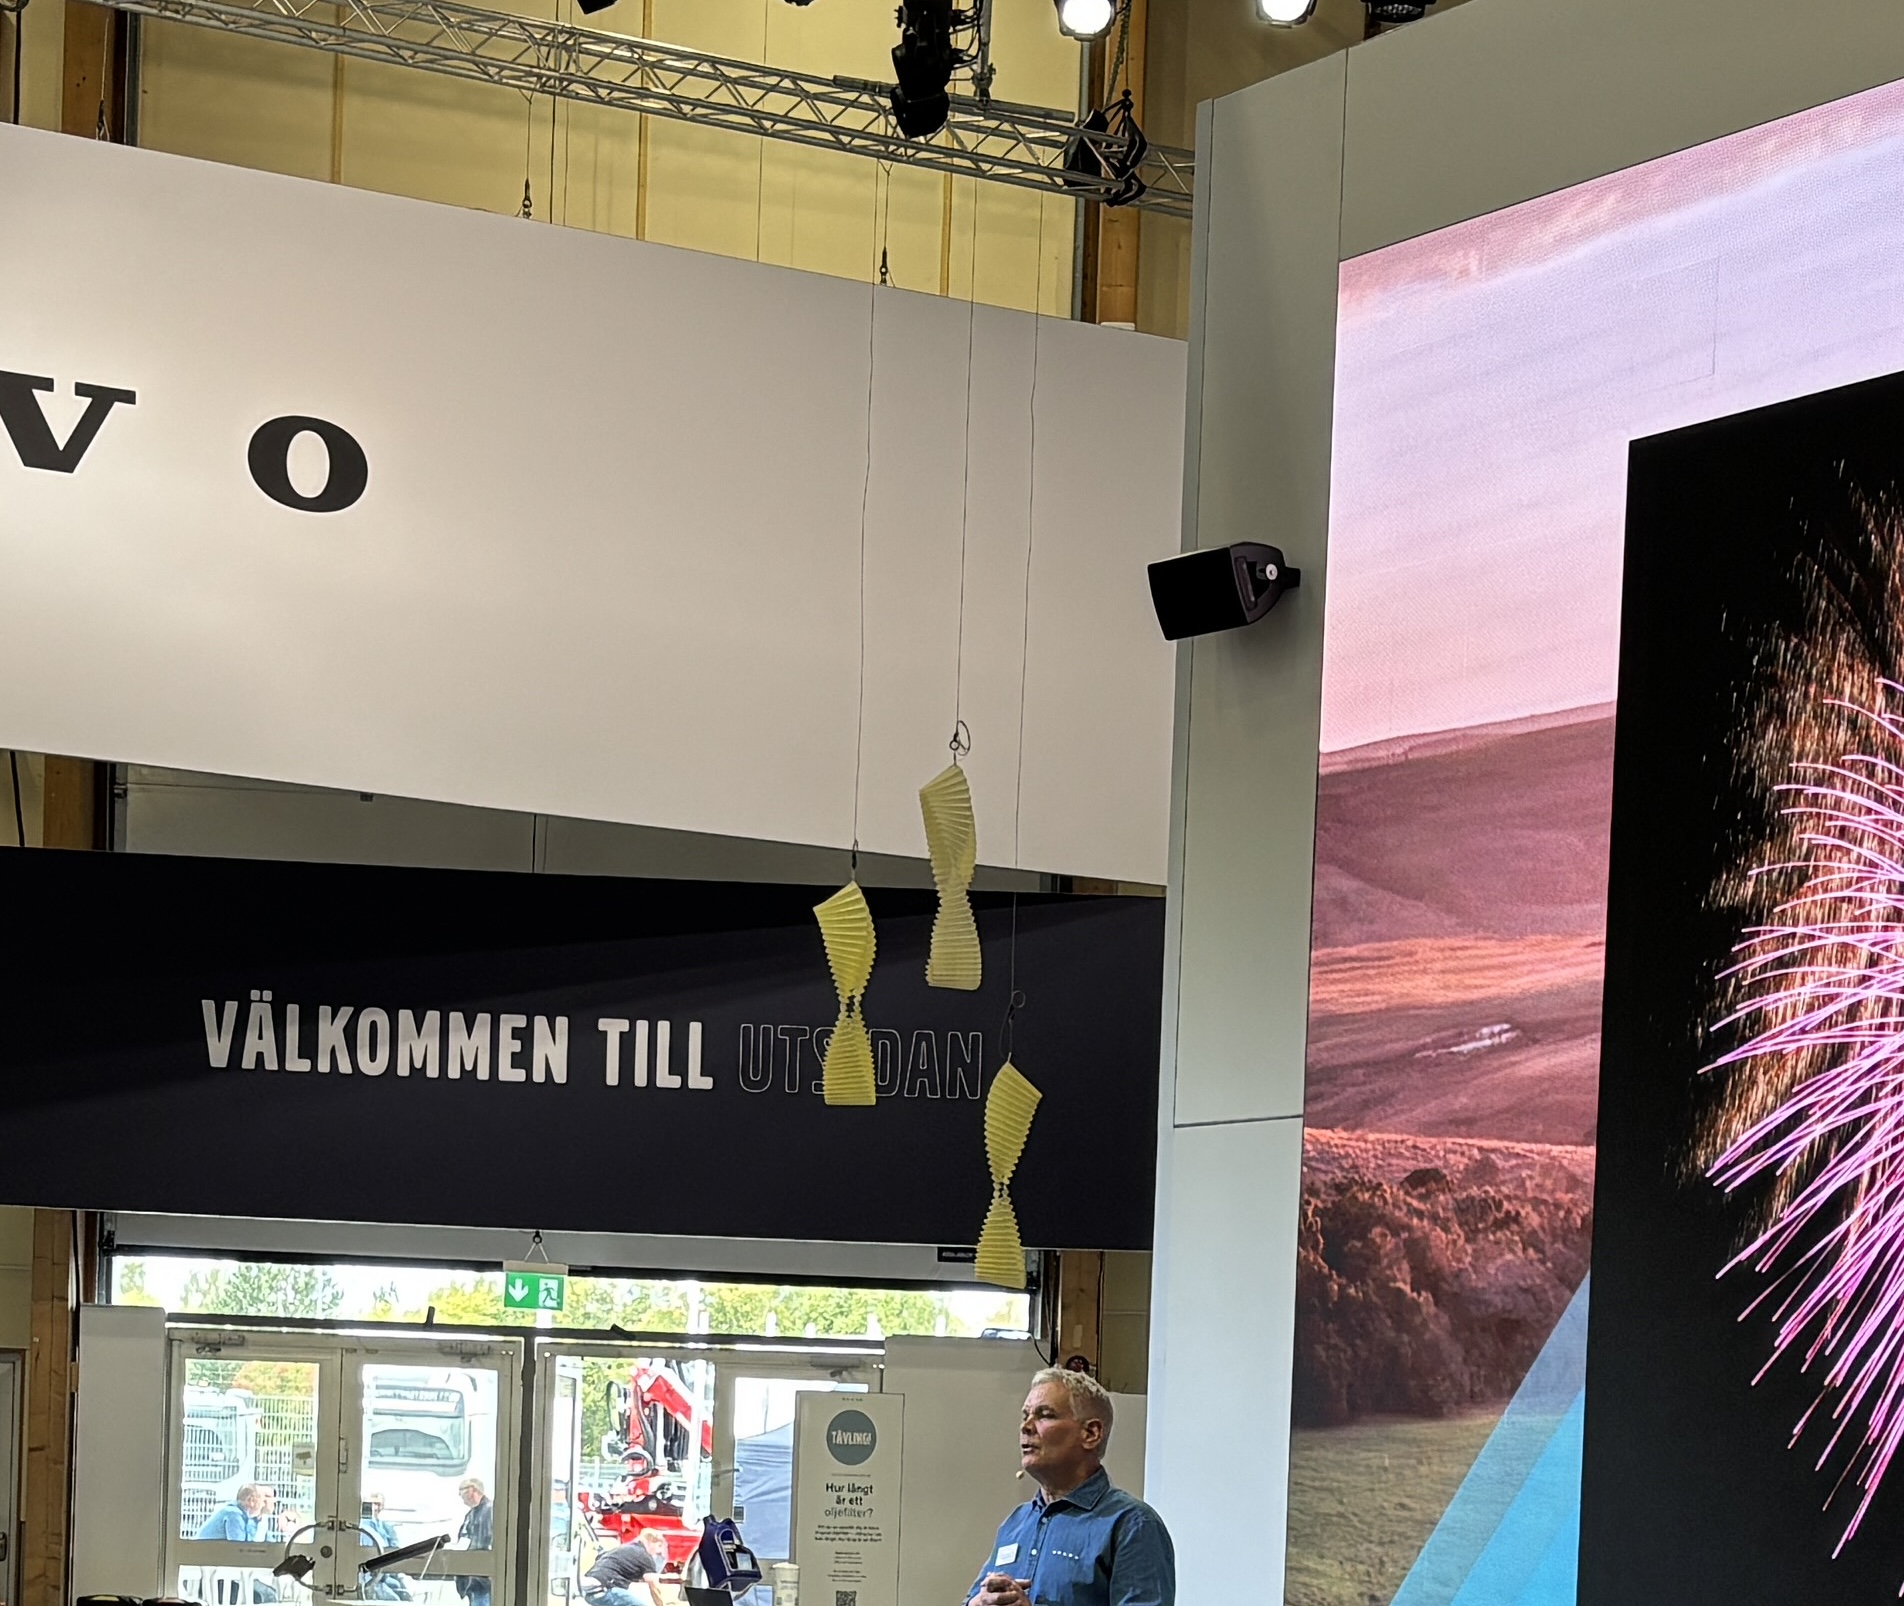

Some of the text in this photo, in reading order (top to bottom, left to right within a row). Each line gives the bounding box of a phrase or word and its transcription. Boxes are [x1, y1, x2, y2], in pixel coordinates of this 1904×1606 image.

[201, 990, 569, 1084] VÄLKOMMEN
[597, 1017, 714, 1090] TILL
[825, 1482, 874, 1496] Hur långt
[835, 1495, 863, 1506] är ett
